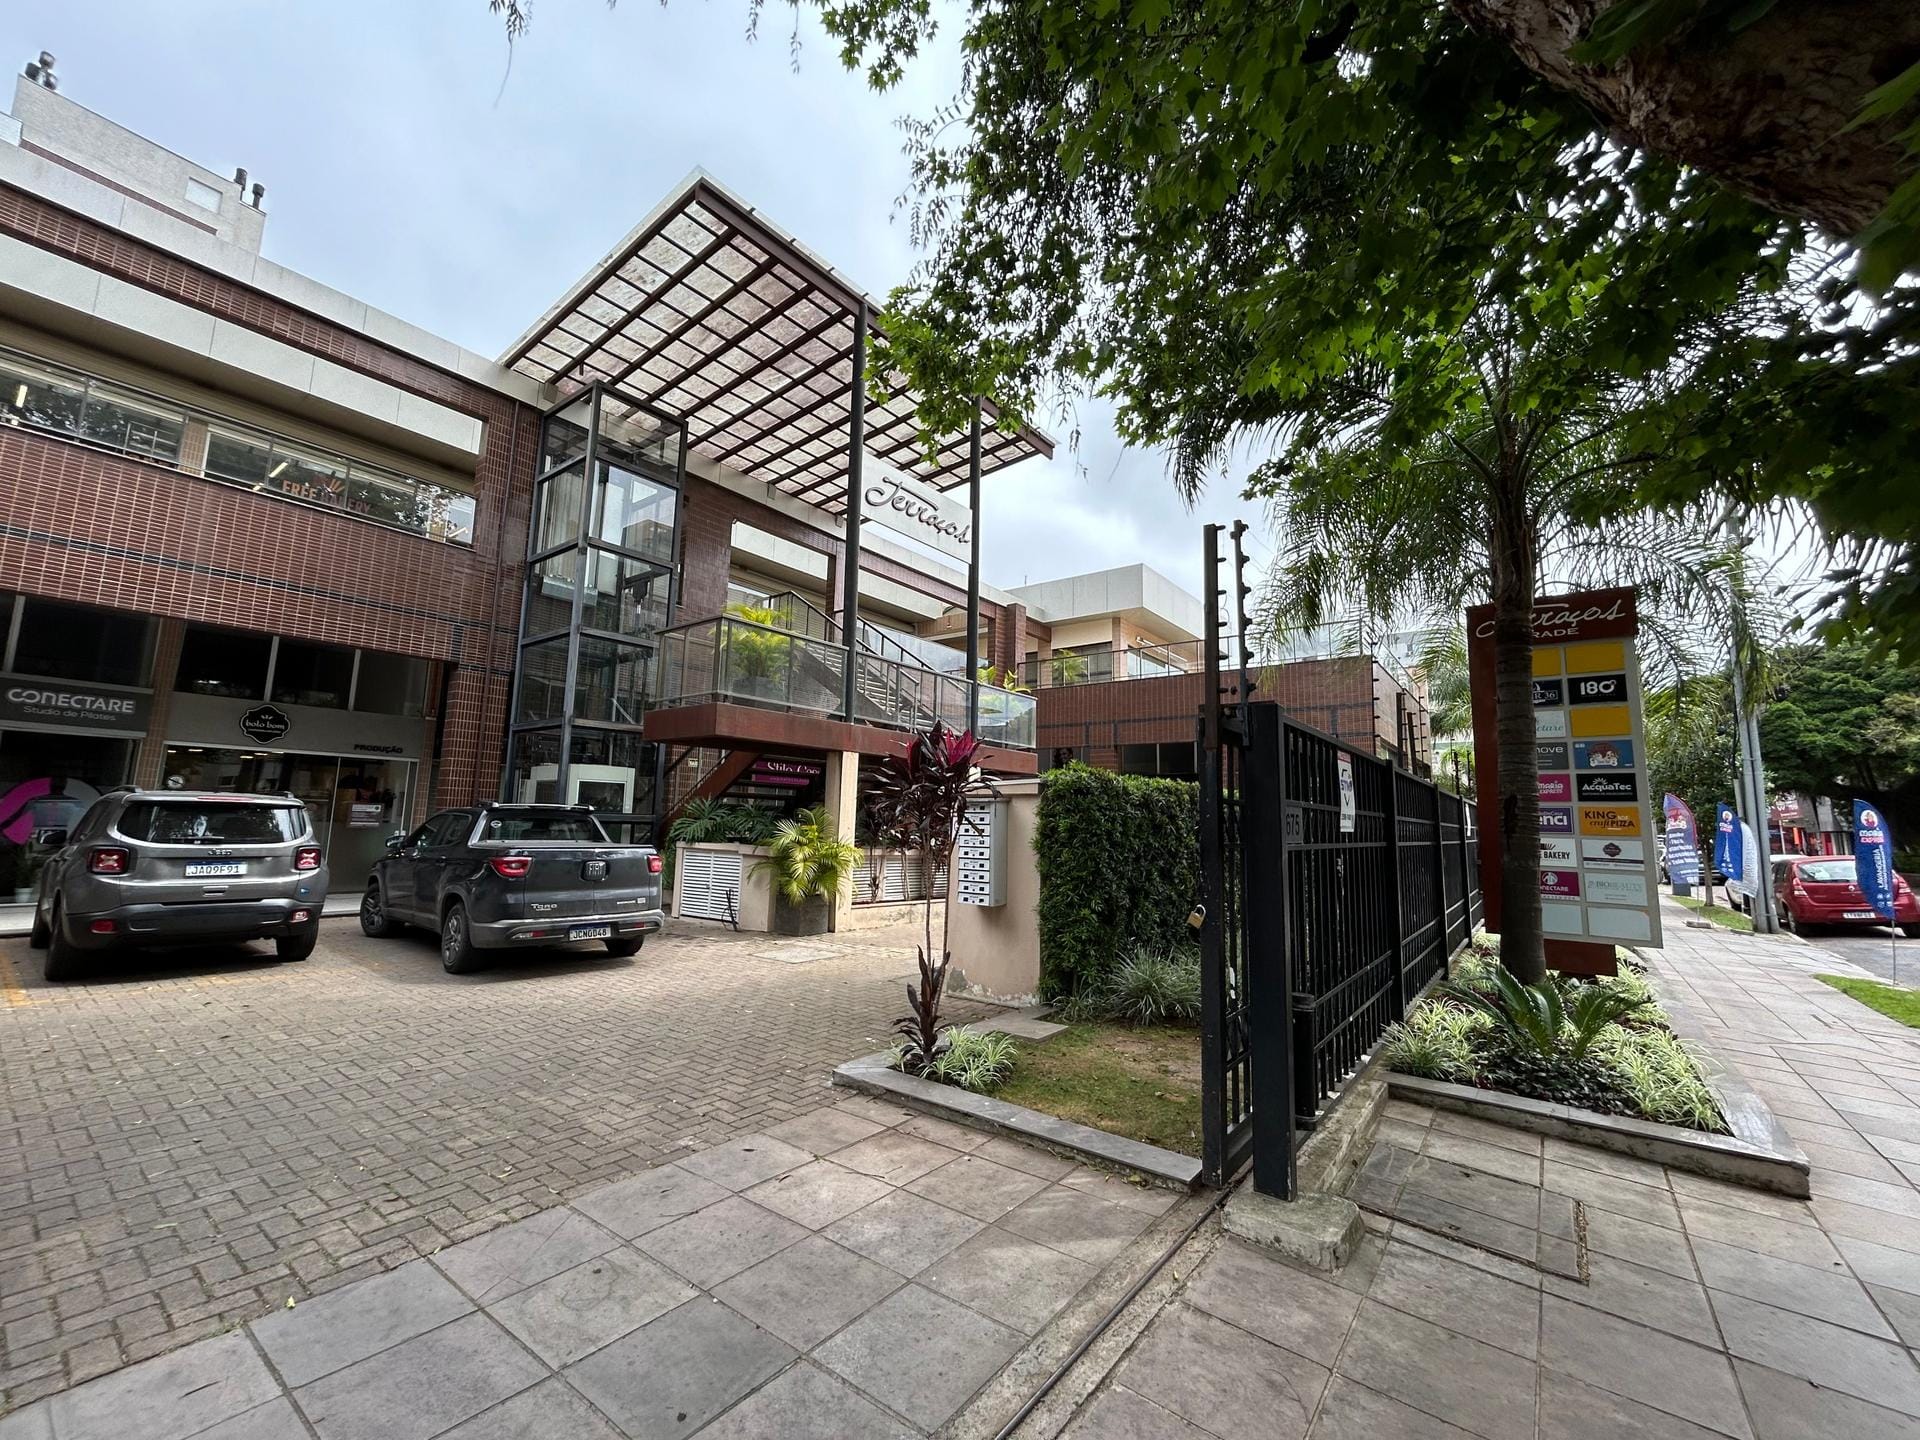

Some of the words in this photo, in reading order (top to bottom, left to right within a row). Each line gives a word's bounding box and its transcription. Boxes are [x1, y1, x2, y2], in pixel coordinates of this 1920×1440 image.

[282, 480, 318, 499] FREE
[320, 493, 372, 513] BAERY
[24, 705, 60, 716] Studio
[354, 744, 403, 754] PRODUÇÃO
[1582, 783, 1632, 792] AcquaTec
[1584, 810, 1617, 820] KING
[1286, 814, 1300, 835] 675
[1611, 820, 1635, 828] PIZZA
[1543, 851, 1570, 860] BAKERY
